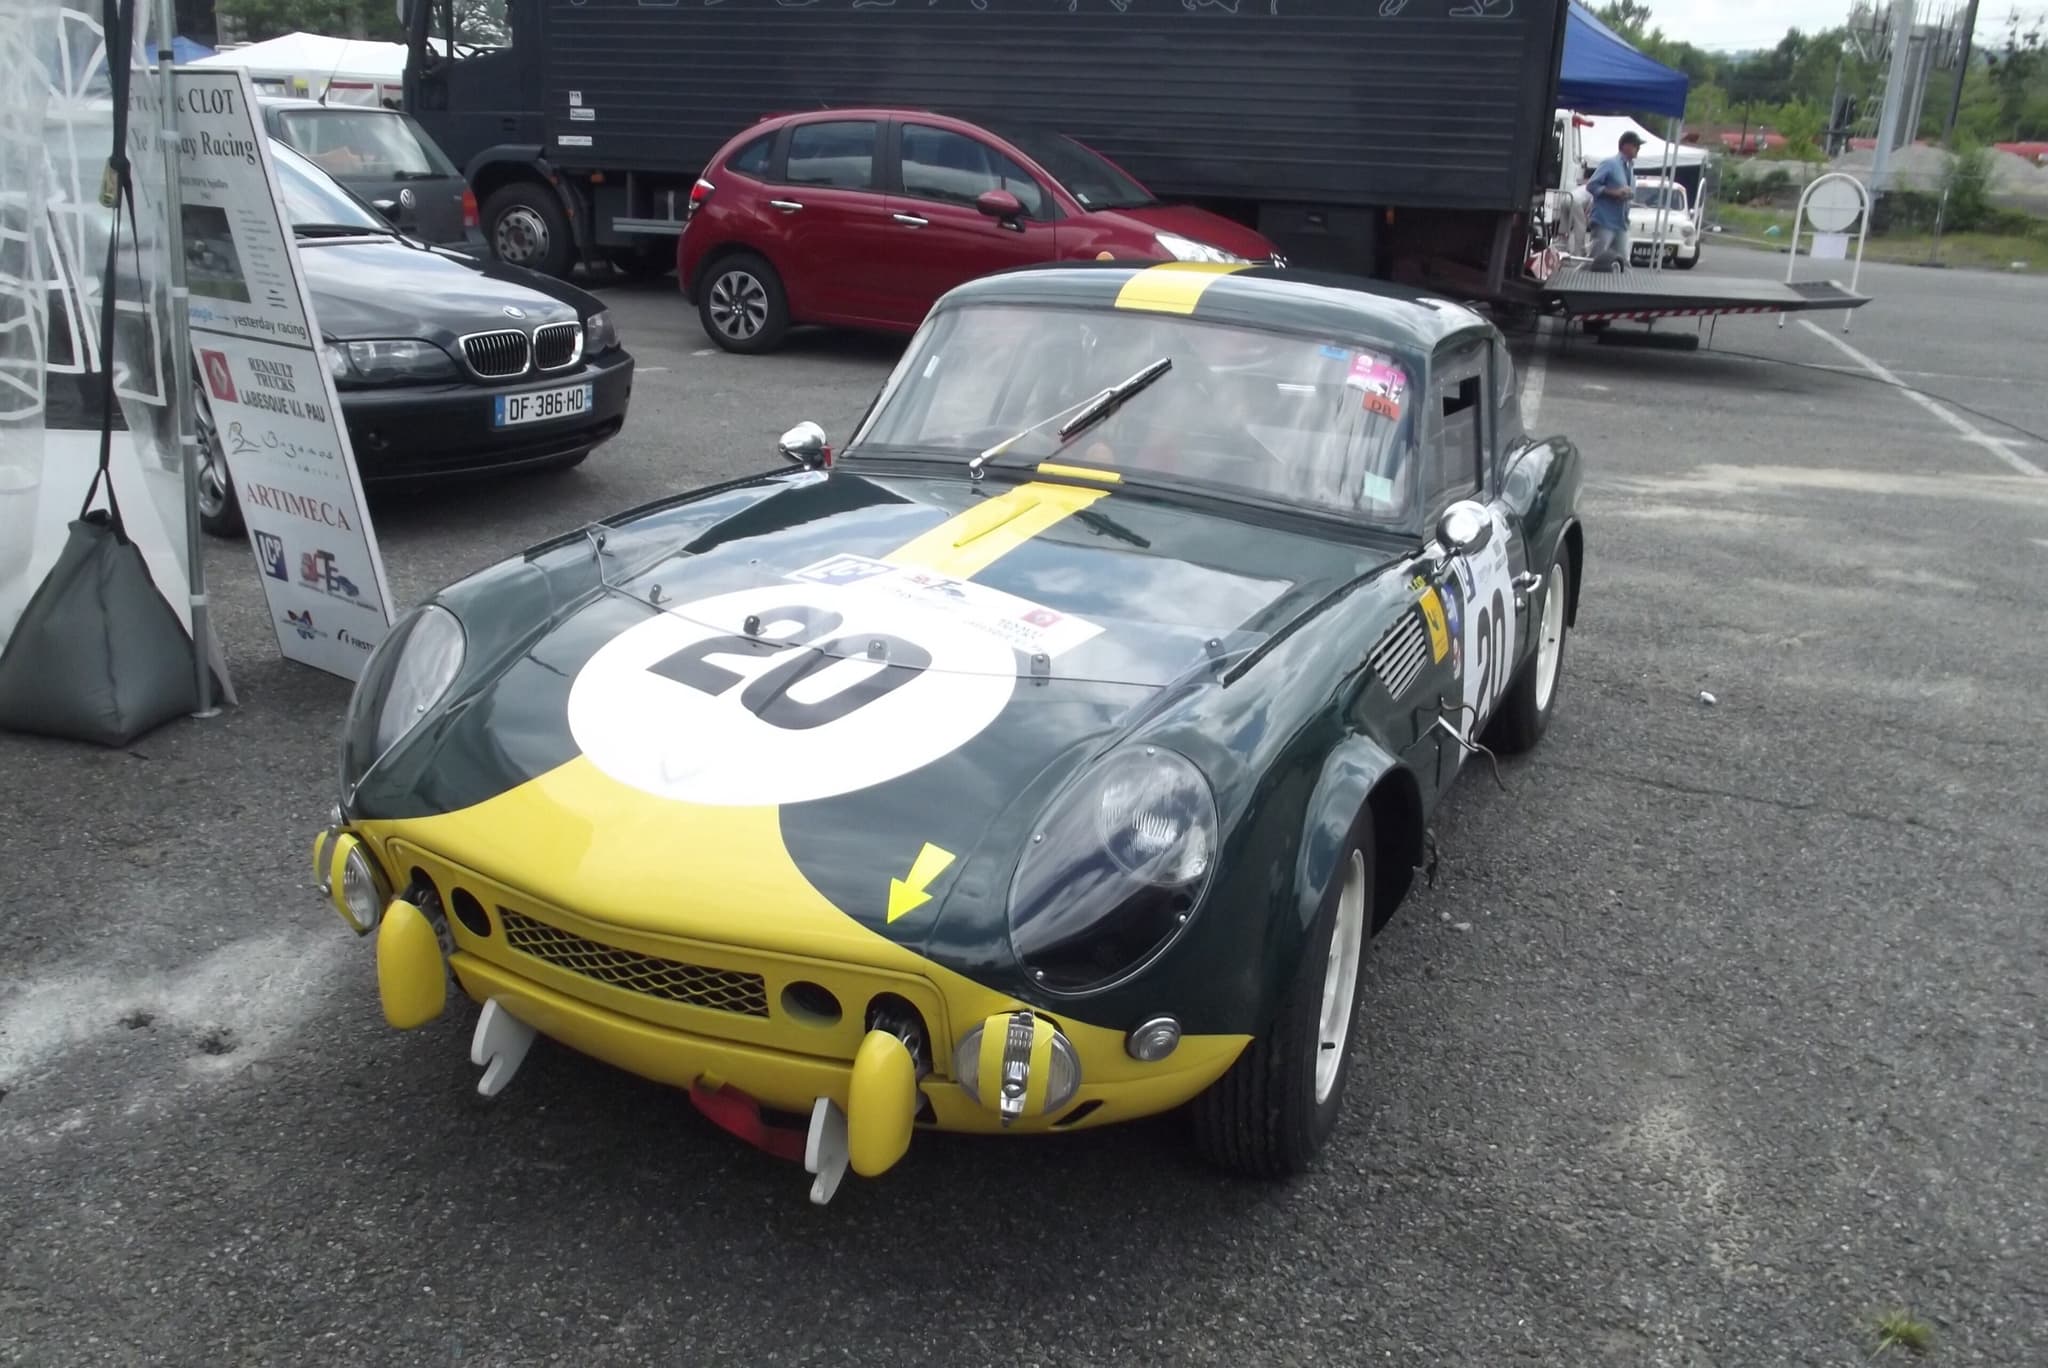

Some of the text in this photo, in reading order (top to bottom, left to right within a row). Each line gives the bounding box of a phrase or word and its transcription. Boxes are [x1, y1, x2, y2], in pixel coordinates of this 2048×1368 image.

[188, 88, 234, 115] CLOT
[200, 131, 256, 165] Racing
[232, 315, 275, 334] yesterday
[277, 321, 307, 340] racing
[248, 357, 294, 378] RENAULT
[254, 373, 296, 393] TRUCKS
[239, 389, 289, 415] LABESQUE
[306, 403, 326, 423] PAU
[247, 482, 352, 532] ARTIMECA
[258, 534, 282, 575] LCP
[646, 605, 933, 730] 20
[1477, 587, 1506, 720] 20
